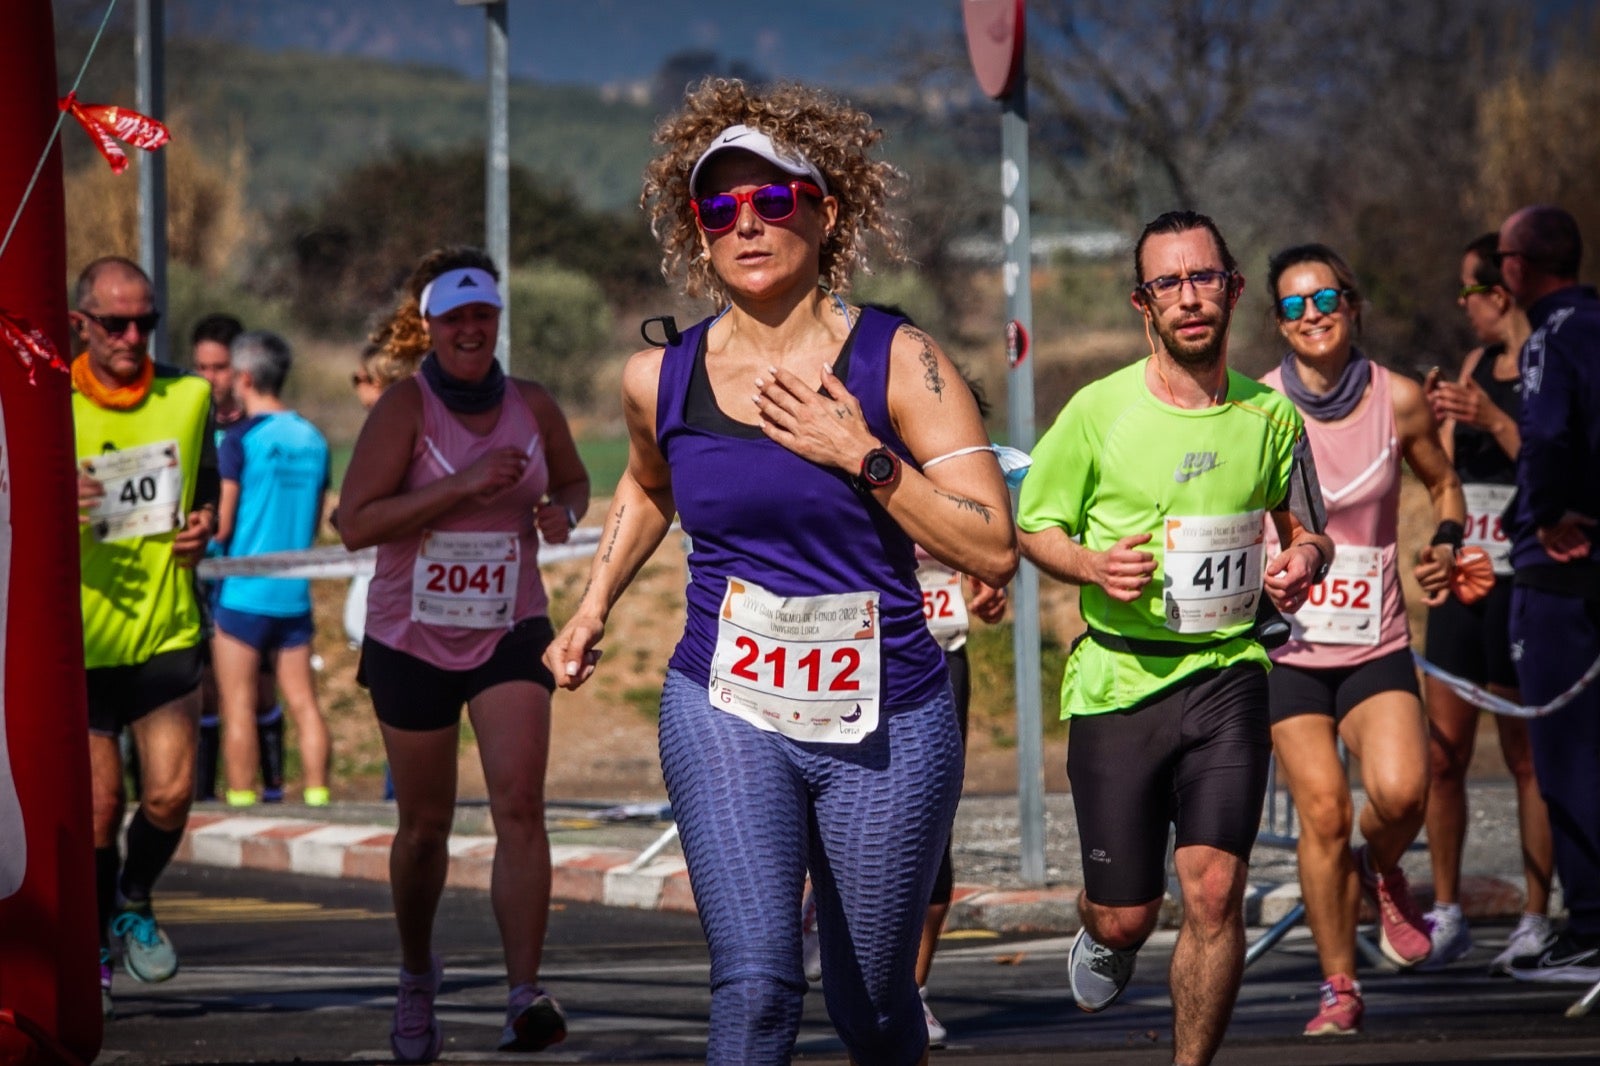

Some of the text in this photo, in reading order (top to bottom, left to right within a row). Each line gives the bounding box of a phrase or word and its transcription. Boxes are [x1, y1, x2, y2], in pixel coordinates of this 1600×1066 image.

[1182, 451, 1218, 469] RUN
[120, 476, 156, 506] 40
[426, 563, 506, 594] 2041
[1192, 551, 1248, 592] 411
[730, 635, 861, 692] 2112
